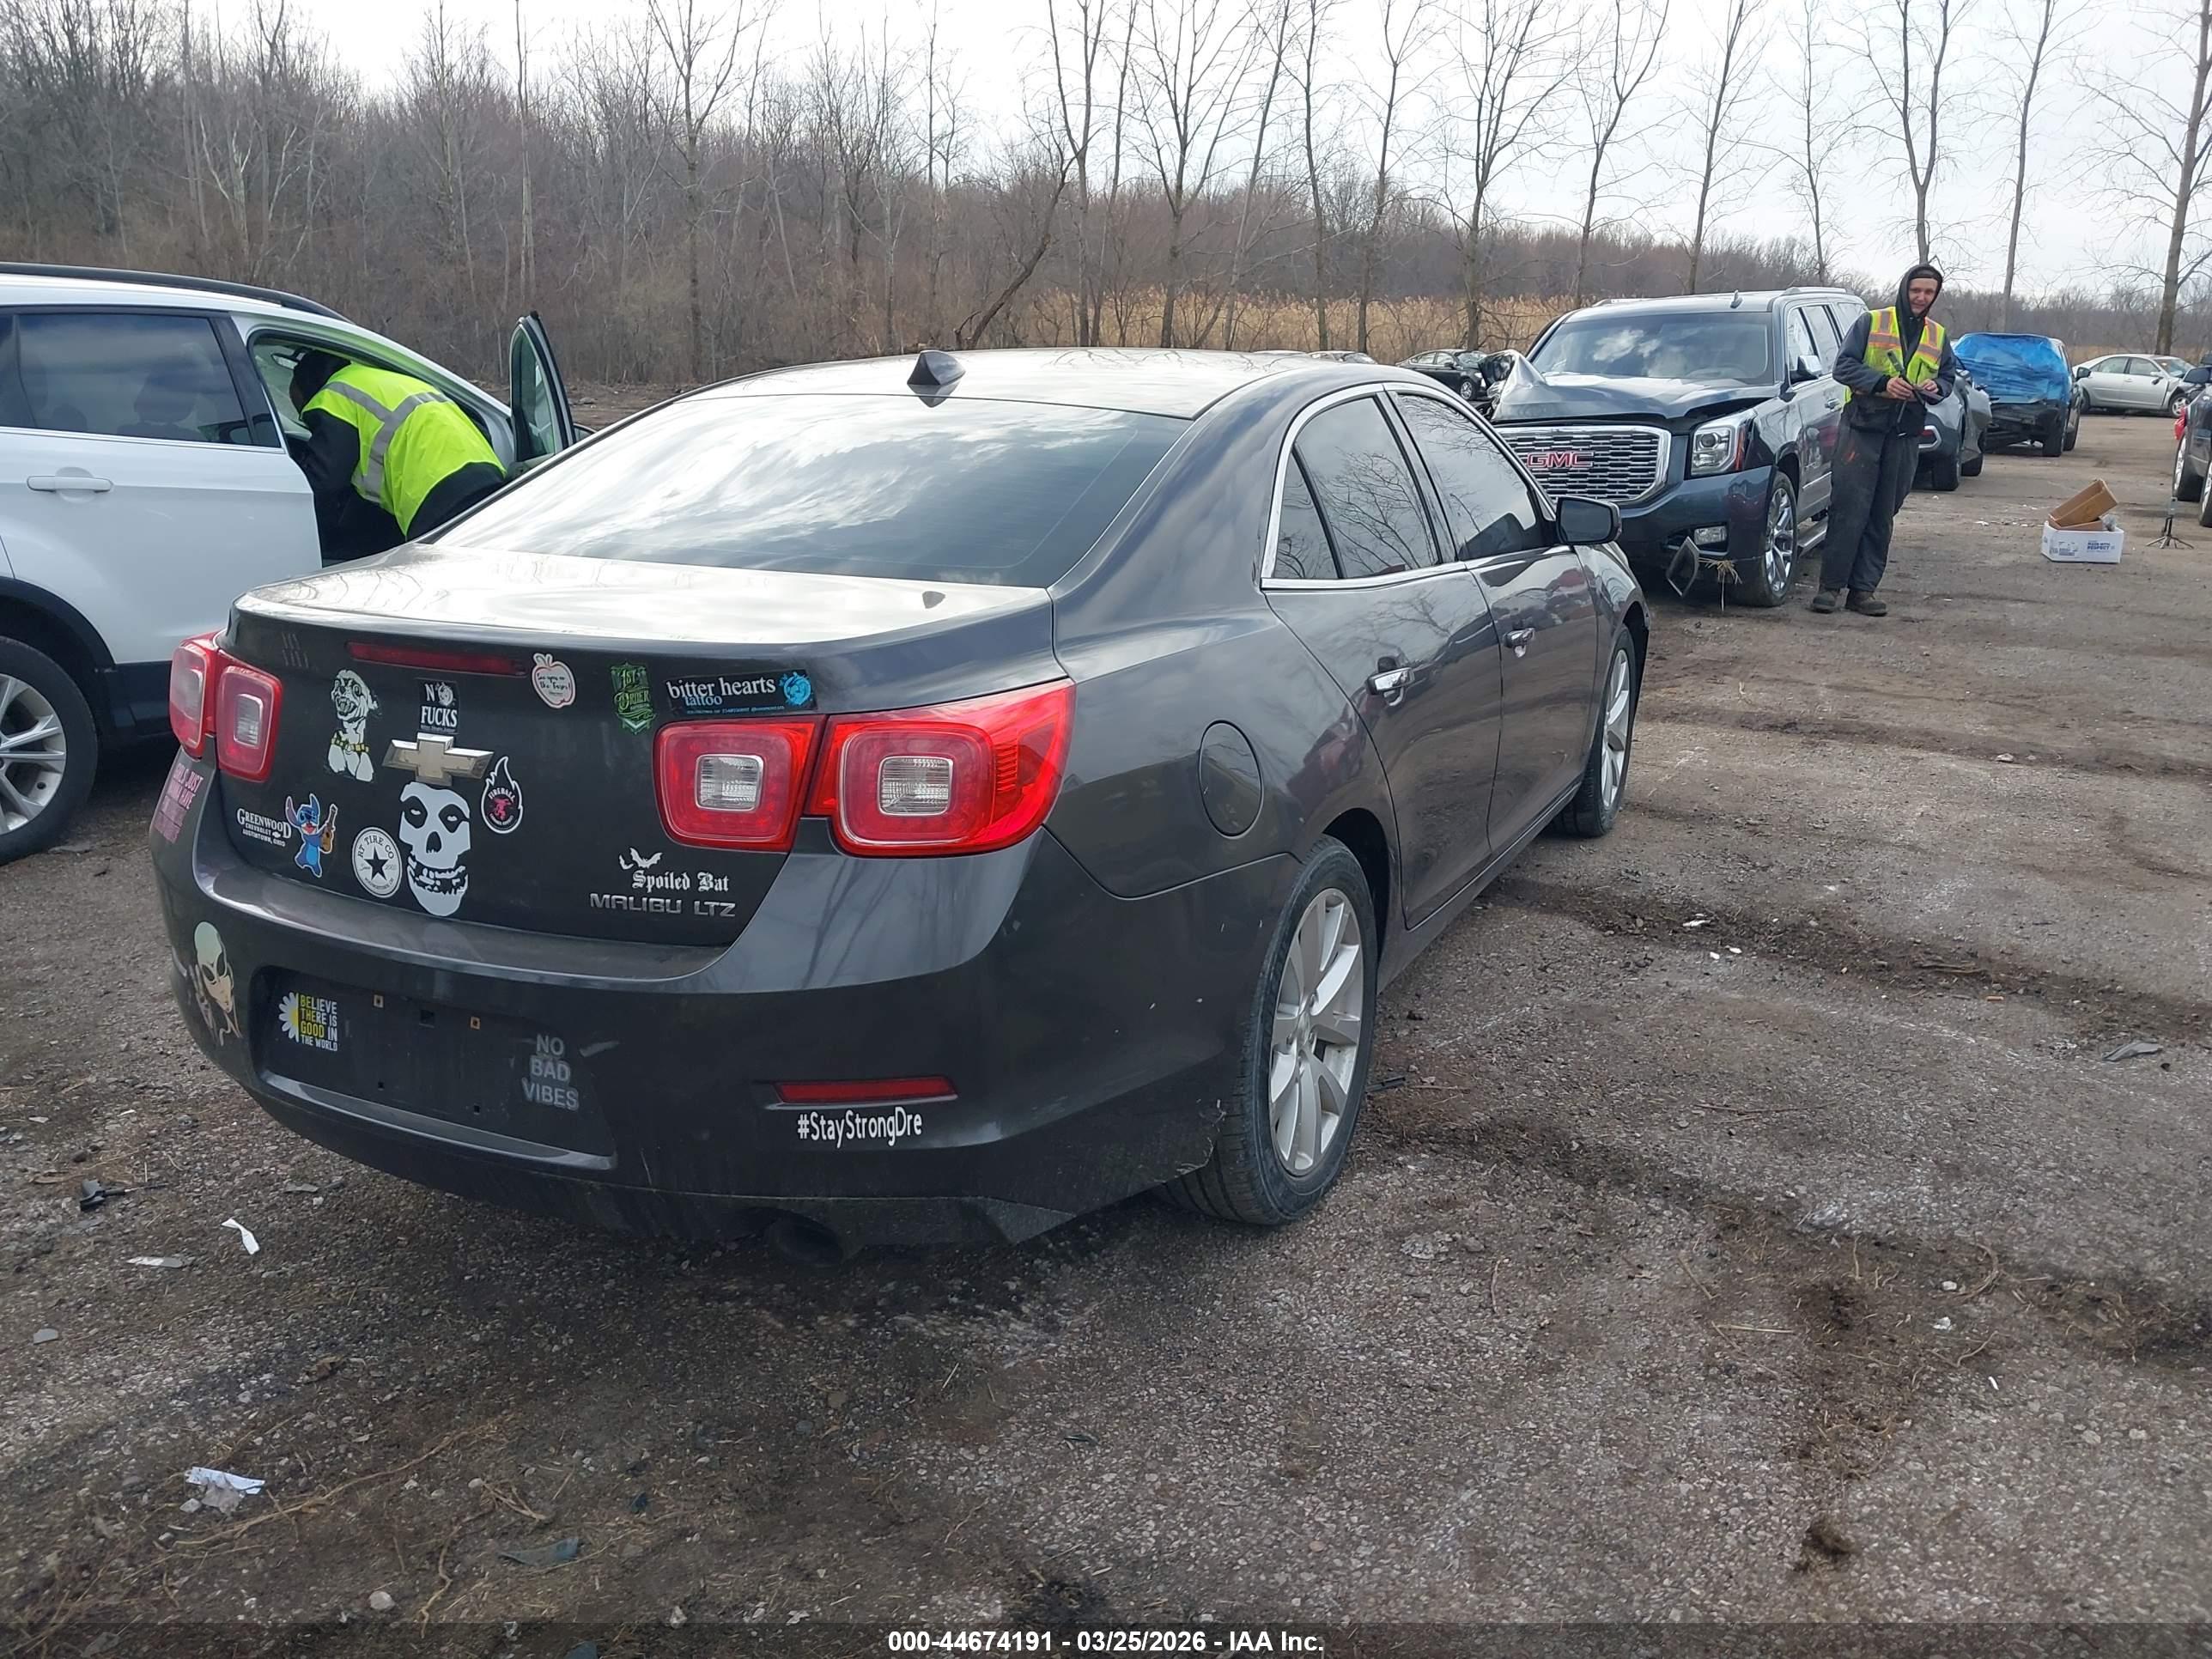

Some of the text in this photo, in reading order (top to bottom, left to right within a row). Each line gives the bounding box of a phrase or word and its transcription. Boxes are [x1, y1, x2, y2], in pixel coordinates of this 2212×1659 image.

[1527, 452, 1595, 468] GMC
[666, 677, 777, 699] bitter hearts
[685, 695, 723, 707] tattoo
[421, 705, 458, 727] FUCKS
[488, 787, 515, 803] FIREBALL
[237, 808, 292, 839] GREENWOOD
[364, 835, 384, 847] TIRE
[385, 844, 394, 859] CO
[632, 870, 730, 893] Spoiled Bat
[590, 893, 736, 917] MALIBU LTZ
[301, 994, 337, 1015] BELIEVE
[301, 1007, 337, 1027] THERE IS
[301, 1020, 337, 1042] GOOD IN
[301, 1034, 337, 1052] THE WORLD
[536, 1034, 564, 1056] NO
[531, 1057, 571, 1082] BAD
[521, 1077, 579, 1110] VIBES
[797, 1106, 923, 1149] #StayStrongDre
